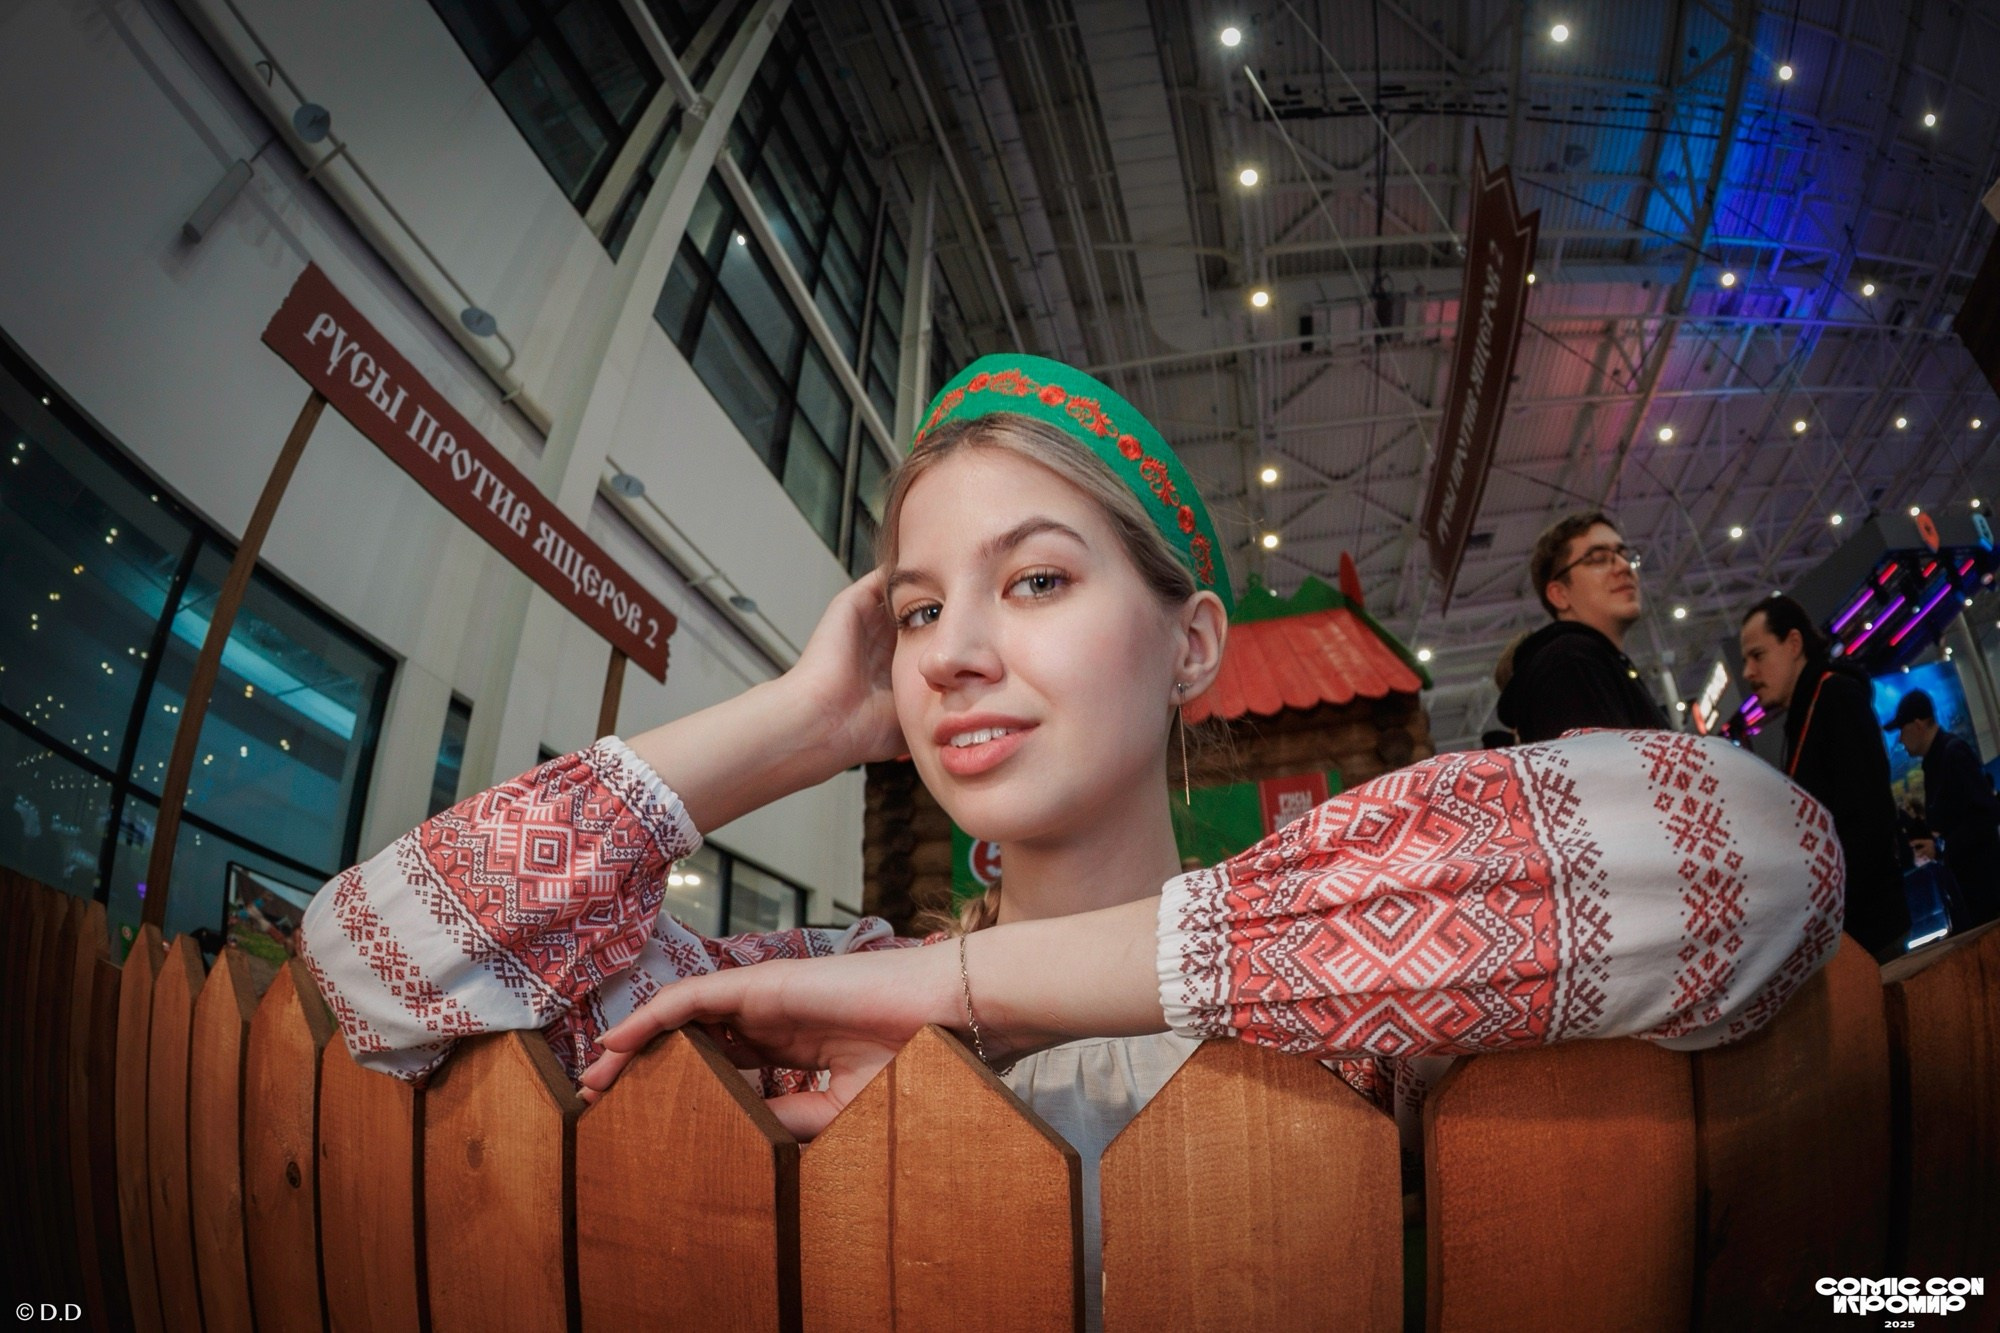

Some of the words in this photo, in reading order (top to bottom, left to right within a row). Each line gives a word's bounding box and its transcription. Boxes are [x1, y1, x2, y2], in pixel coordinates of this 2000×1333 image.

[303, 313, 408, 423] РУСЫ
[406, 405, 532, 538] ПРОТИВ
[532, 520, 643, 636] ЯЩЕРОВ
[643, 618, 660, 651] 2
